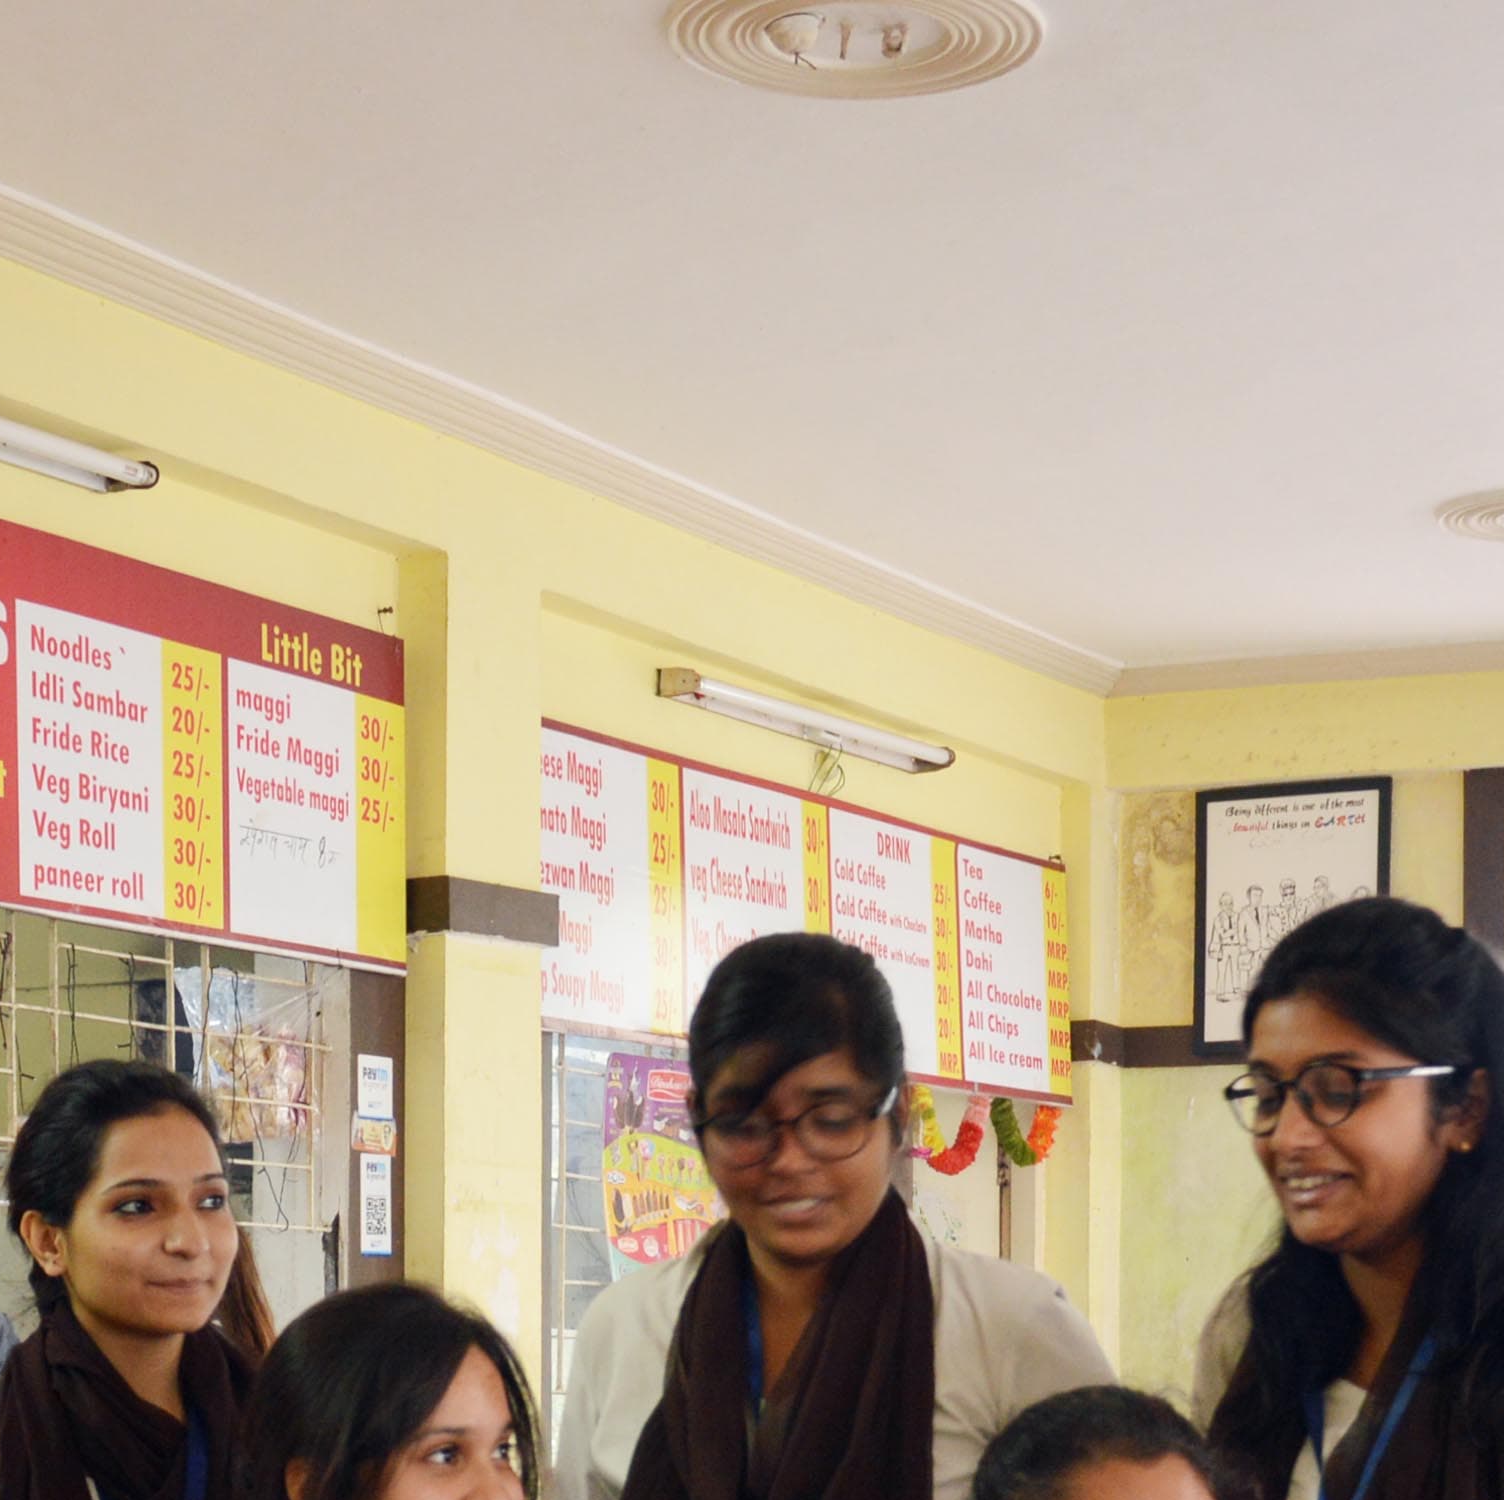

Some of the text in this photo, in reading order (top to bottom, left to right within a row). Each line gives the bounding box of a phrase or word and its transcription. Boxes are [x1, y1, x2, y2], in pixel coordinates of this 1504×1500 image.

[31, 625, 111, 670] Noodles
[262, 624, 362, 686] Little Bit
[32, 671, 148, 723] Idli Sambar
[236, 689, 290, 724] maggi
[32, 717, 129, 764] Fride Rice
[237, 724, 339, 778] Fride Maggi
[32, 763, 148, 813] Veg Biryani
[237, 767, 349, 822] Vegetable maggi
[567, 751, 602, 798] Maggi
[571, 806, 606, 852] Maggi
[690, 790, 790, 849] Aloo Masala Sandwich
[877, 832, 910, 863] DRINK
[34, 864, 143, 900] paneer roll
[835, 858, 854, 882] Cold
[857, 864, 886, 890] Coffee
[963, 858, 983, 880] Tea
[964, 889, 1002, 915] Coffee
[965, 919, 1002, 944] Matha
[966, 949, 992, 971] Dahi
[967, 980, 1042, 1012] All Chocolate
[968, 1011, 1019, 1039] All Chips
